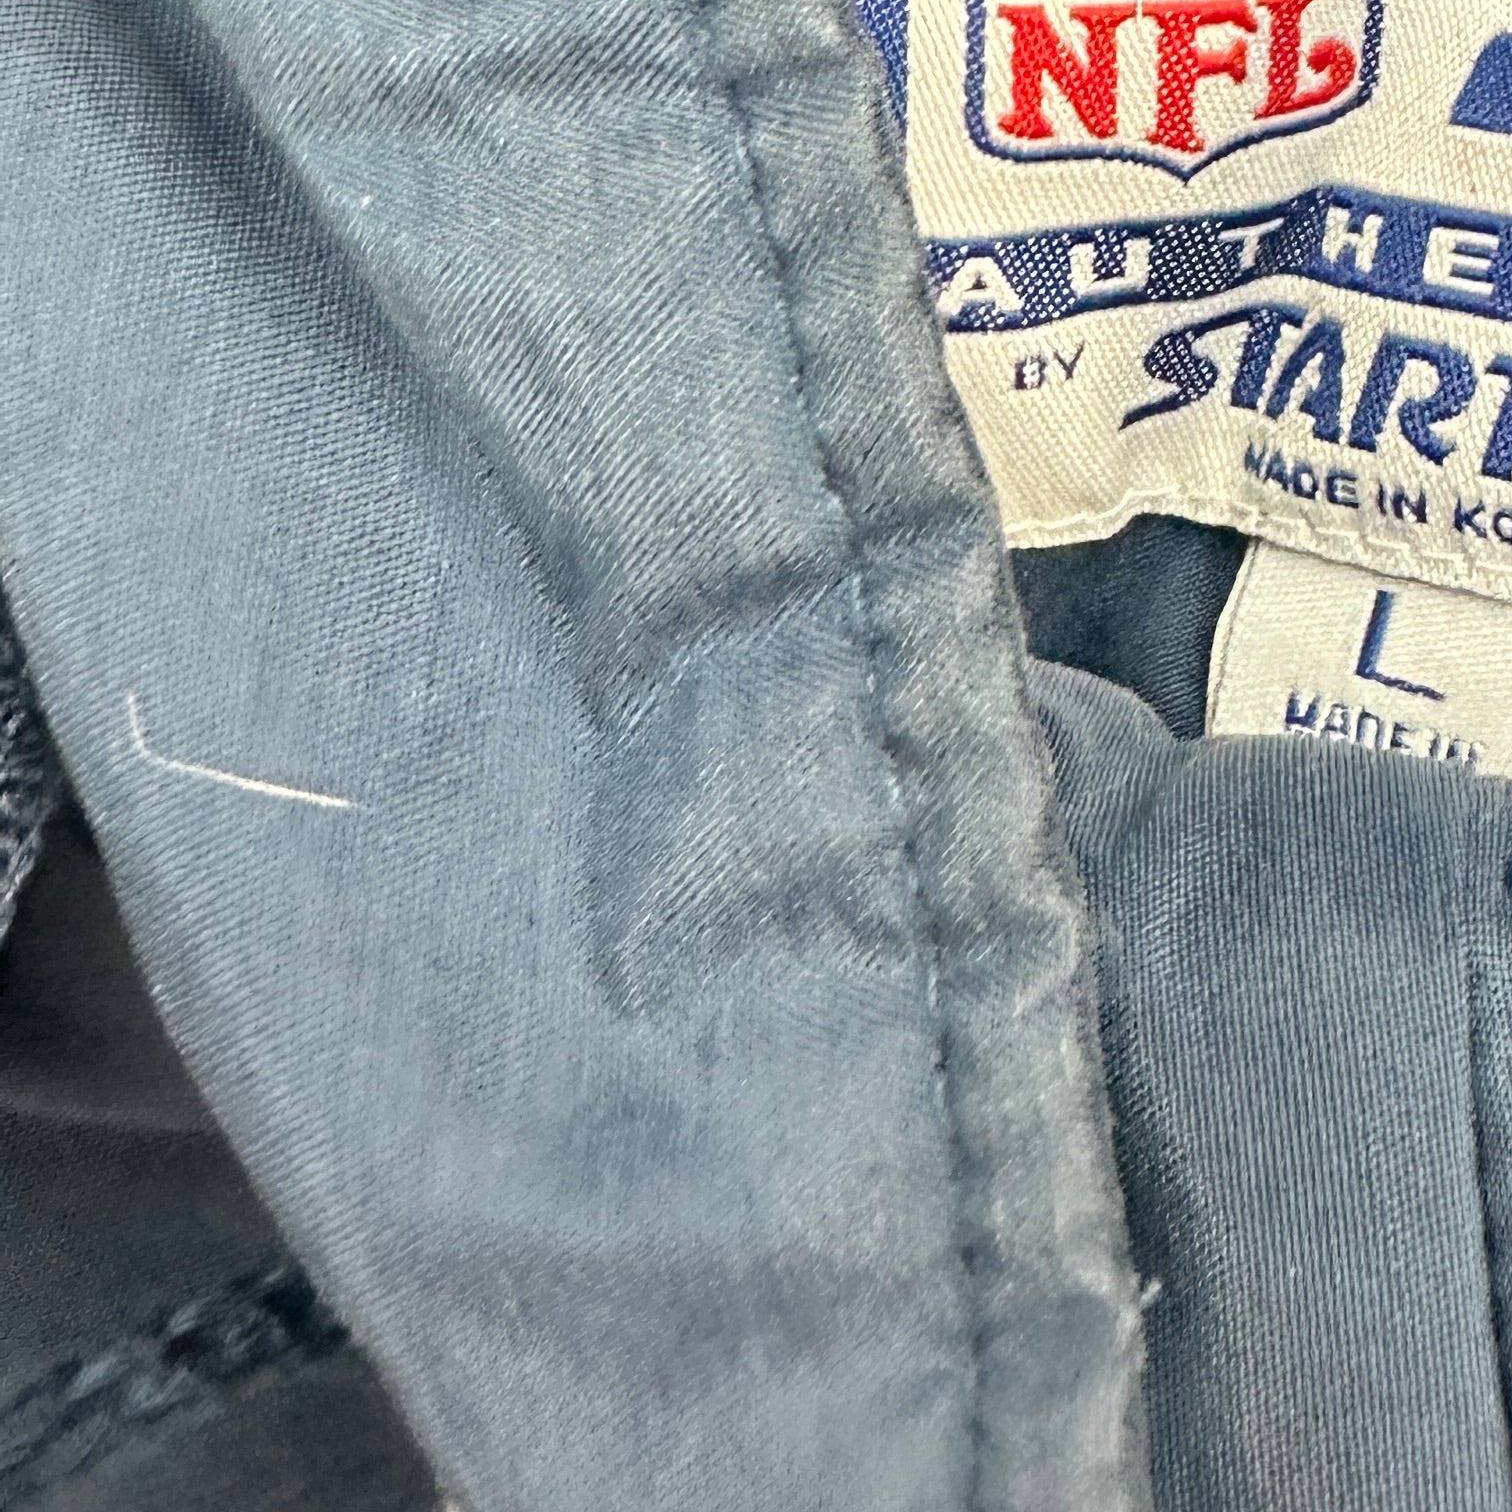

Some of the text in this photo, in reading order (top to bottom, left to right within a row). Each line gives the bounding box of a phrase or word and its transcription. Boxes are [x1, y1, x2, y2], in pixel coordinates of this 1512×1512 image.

[1014, 342, 1085, 389] BY
[1244, 443, 1360, 508] MADE
[1378, 485, 1428, 523] IN
[1355, 589, 1446, 701] L
